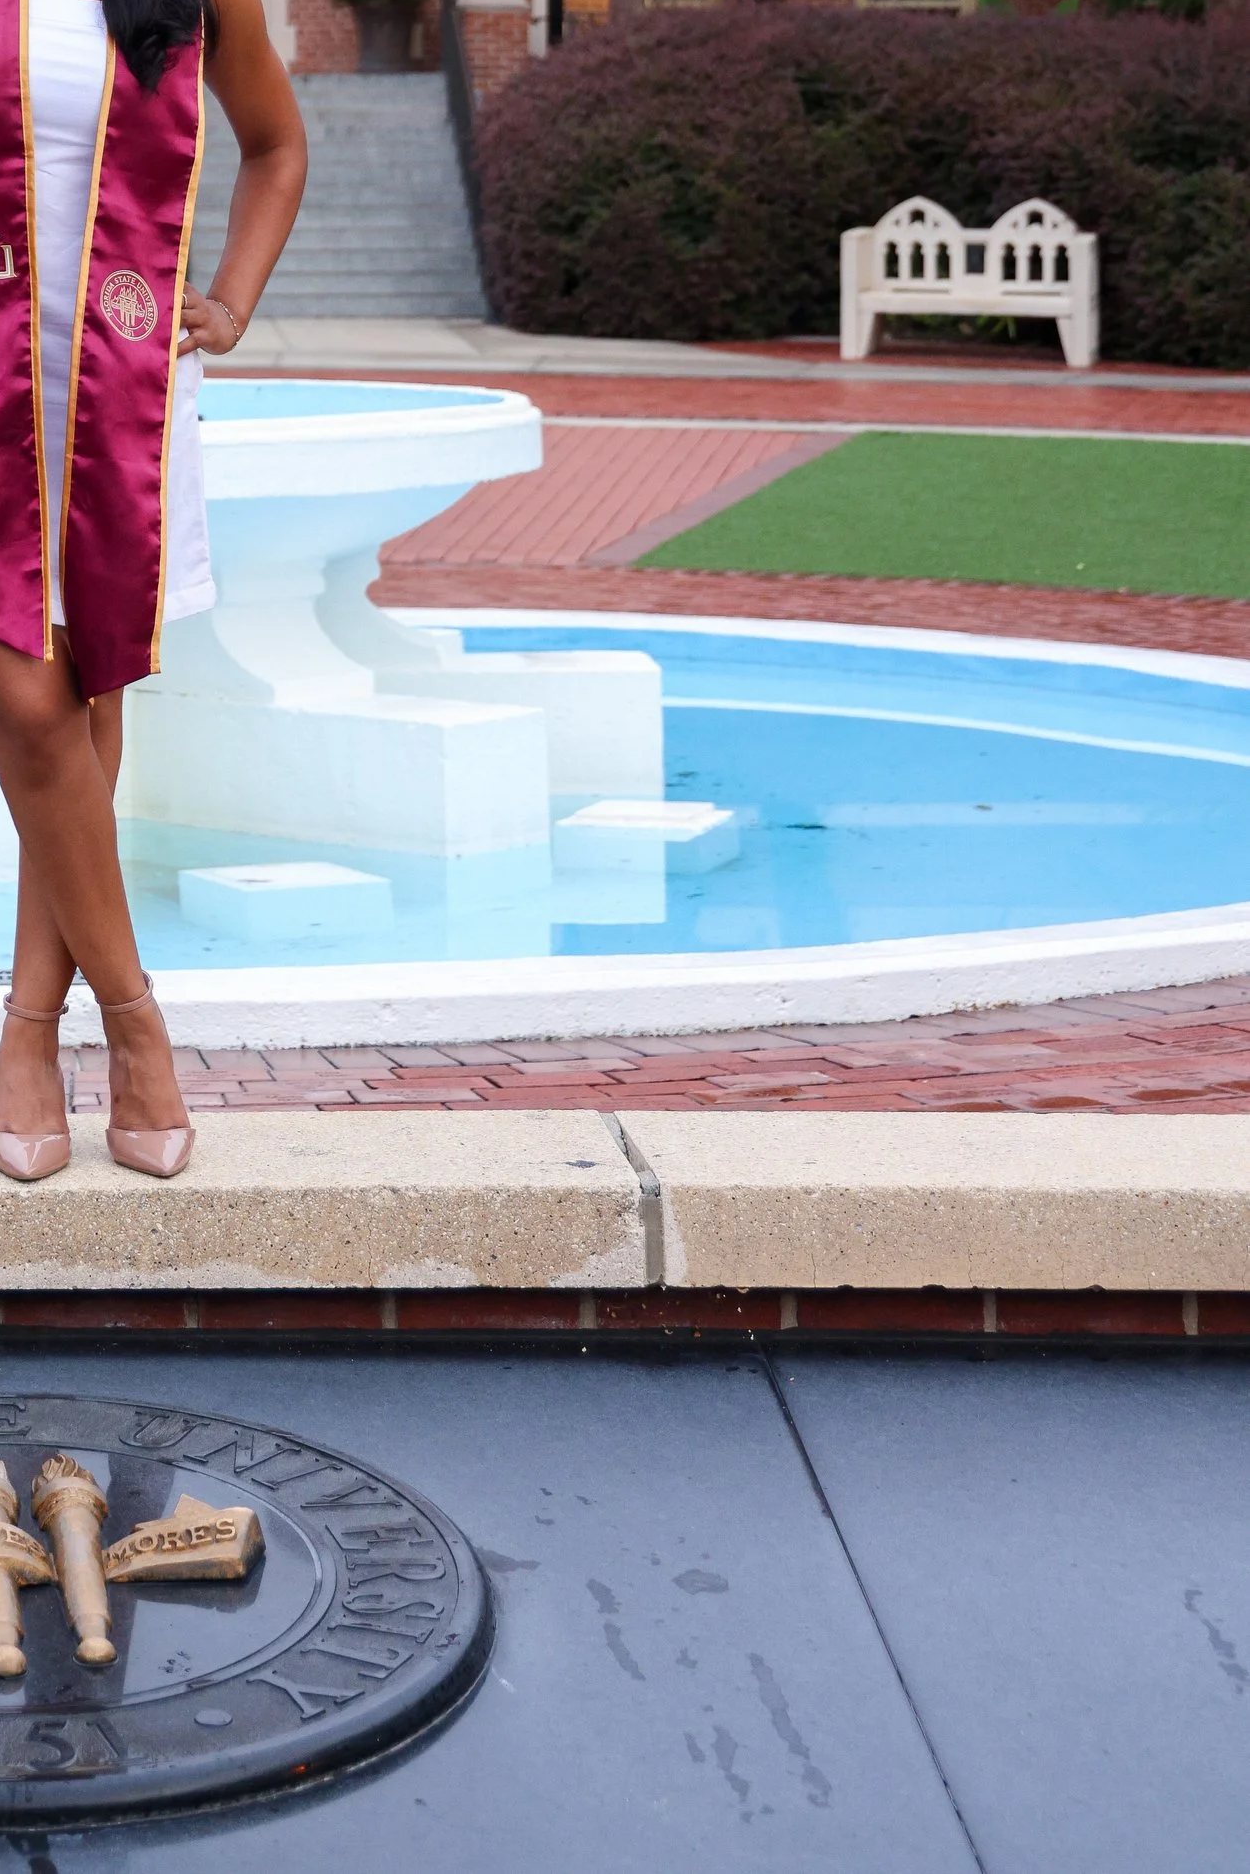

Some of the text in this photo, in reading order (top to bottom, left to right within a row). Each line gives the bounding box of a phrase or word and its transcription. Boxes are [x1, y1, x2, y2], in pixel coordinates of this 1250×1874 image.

[103, 275, 154, 331] FLORIDA STATE UNIVERSITY
[121, 326, 135, 337] 1851
[102, 1517, 237, 1569] MORES
[118, 1410, 447, 1719] UNIVERSITY
